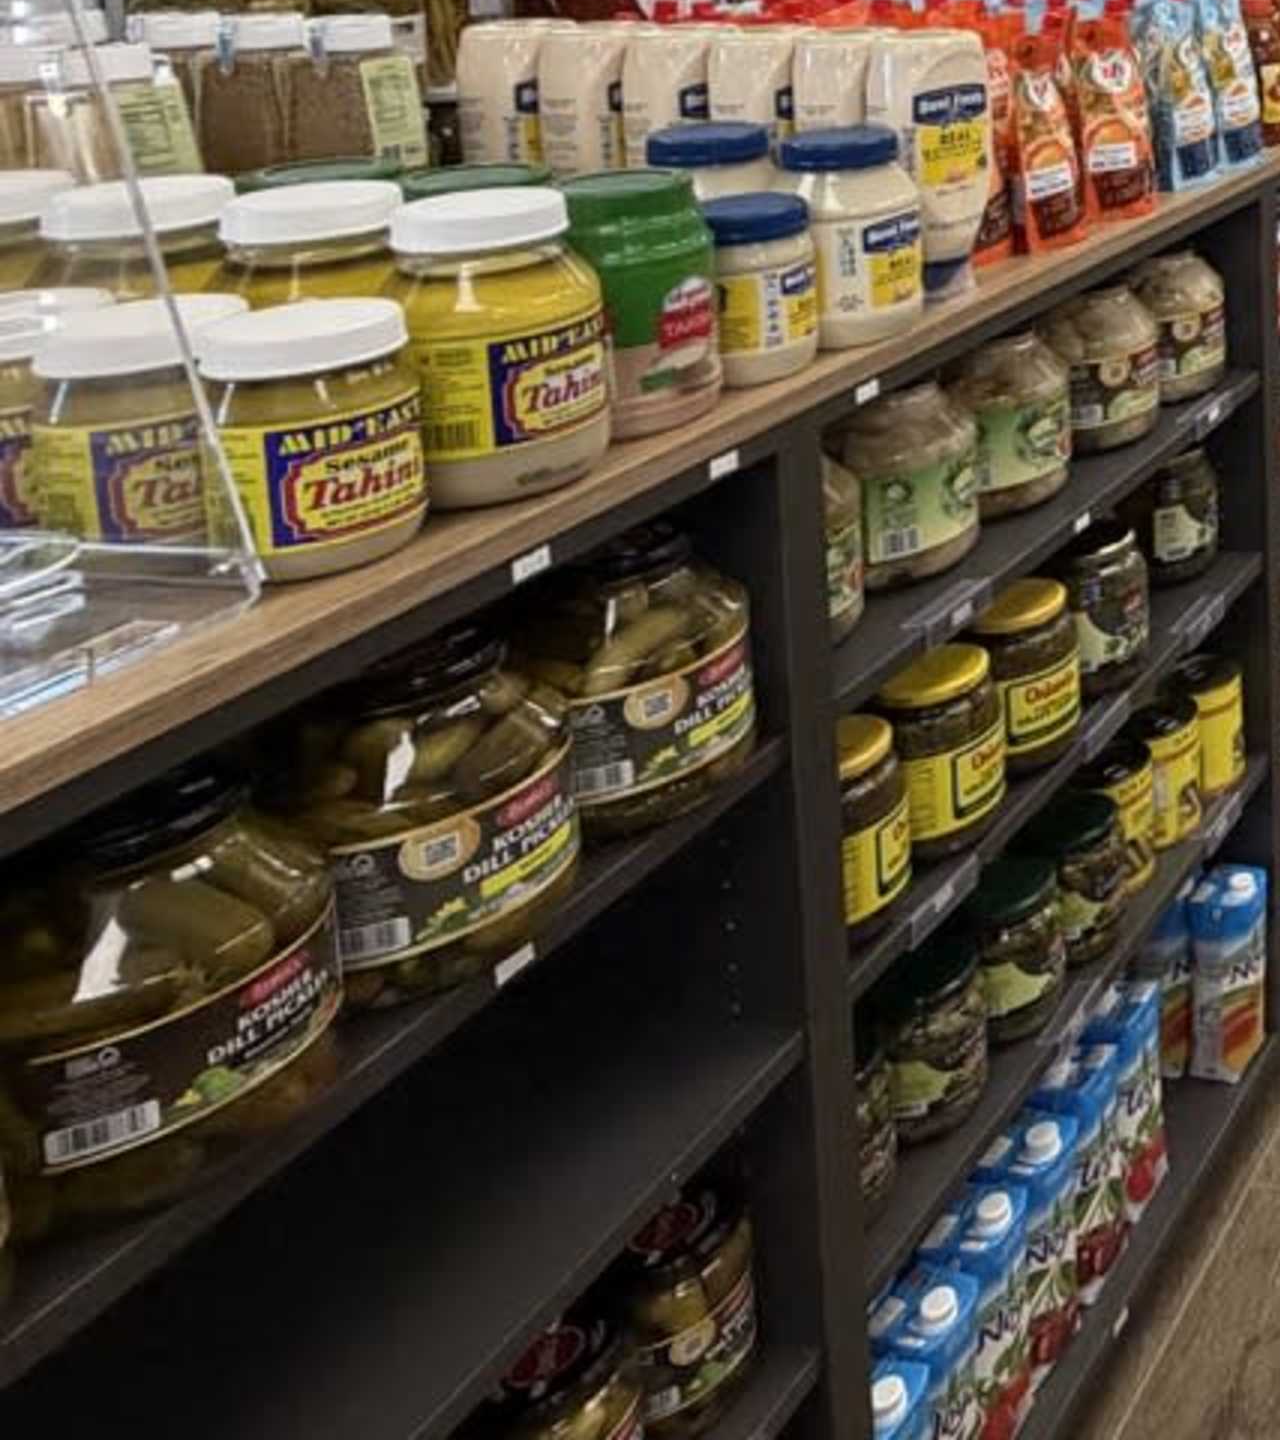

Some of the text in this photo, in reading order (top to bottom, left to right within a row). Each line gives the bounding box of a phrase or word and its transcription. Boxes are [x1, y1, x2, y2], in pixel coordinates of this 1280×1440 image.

[280, 425, 354, 457] MID
[463, 850, 515, 884] DILL
[207, 1028, 261, 1065] DILL
